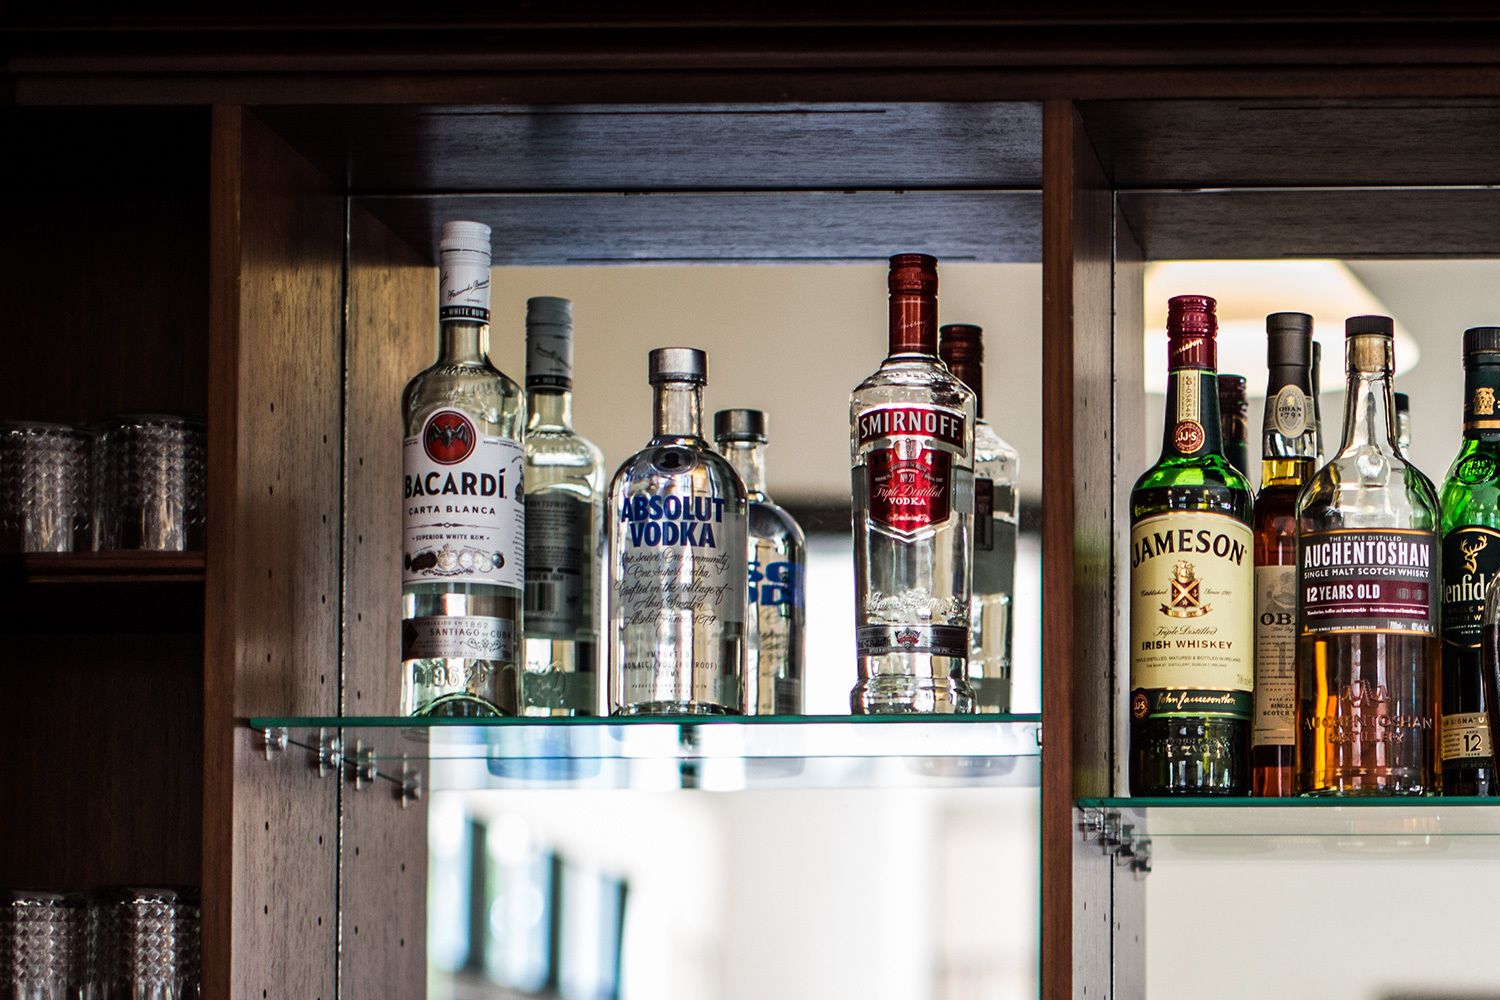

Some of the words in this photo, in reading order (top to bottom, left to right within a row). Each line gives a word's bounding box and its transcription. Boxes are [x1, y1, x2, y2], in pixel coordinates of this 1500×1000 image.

[449, 307, 469, 316] WHITE
[472, 308, 484, 317] RUM
[861, 410, 962, 442] SMIRNOFF
[405, 468, 506, 499] BACARDÍ
[873, 484, 900, 503] Triple
[900, 483, 945, 499] Distilled
[889, 496, 927, 506] VODKA
[409, 505, 440, 516] CARTA
[446, 506, 496, 515] BLANCA
[621, 495, 725, 523] ABSOLUT
[629, 522, 717, 548] VODKA
[1133, 529, 1245, 569] JAMESON
[1304, 541, 1430, 568] AUCHENTOSHAN
[1304, 570, 1329, 579] SINGLE
[1332, 568, 1354, 576] MALT
[1358, 568, 1396, 576] SCOTCH
[1398, 568, 1430, 578] WHISKY
[1306, 586, 1318, 602] 12
[1319, 584, 1354, 600] YEARS
[1358, 584, 1381, 600] OLD
[430, 628, 480, 637] SANTIAGO
[1152, 625, 1177, 640] Triple
[1142, 640, 1170, 650] IRISH
[1176, 640, 1232, 650] WHISKEY
[1463, 734, 1482, 752] 12
